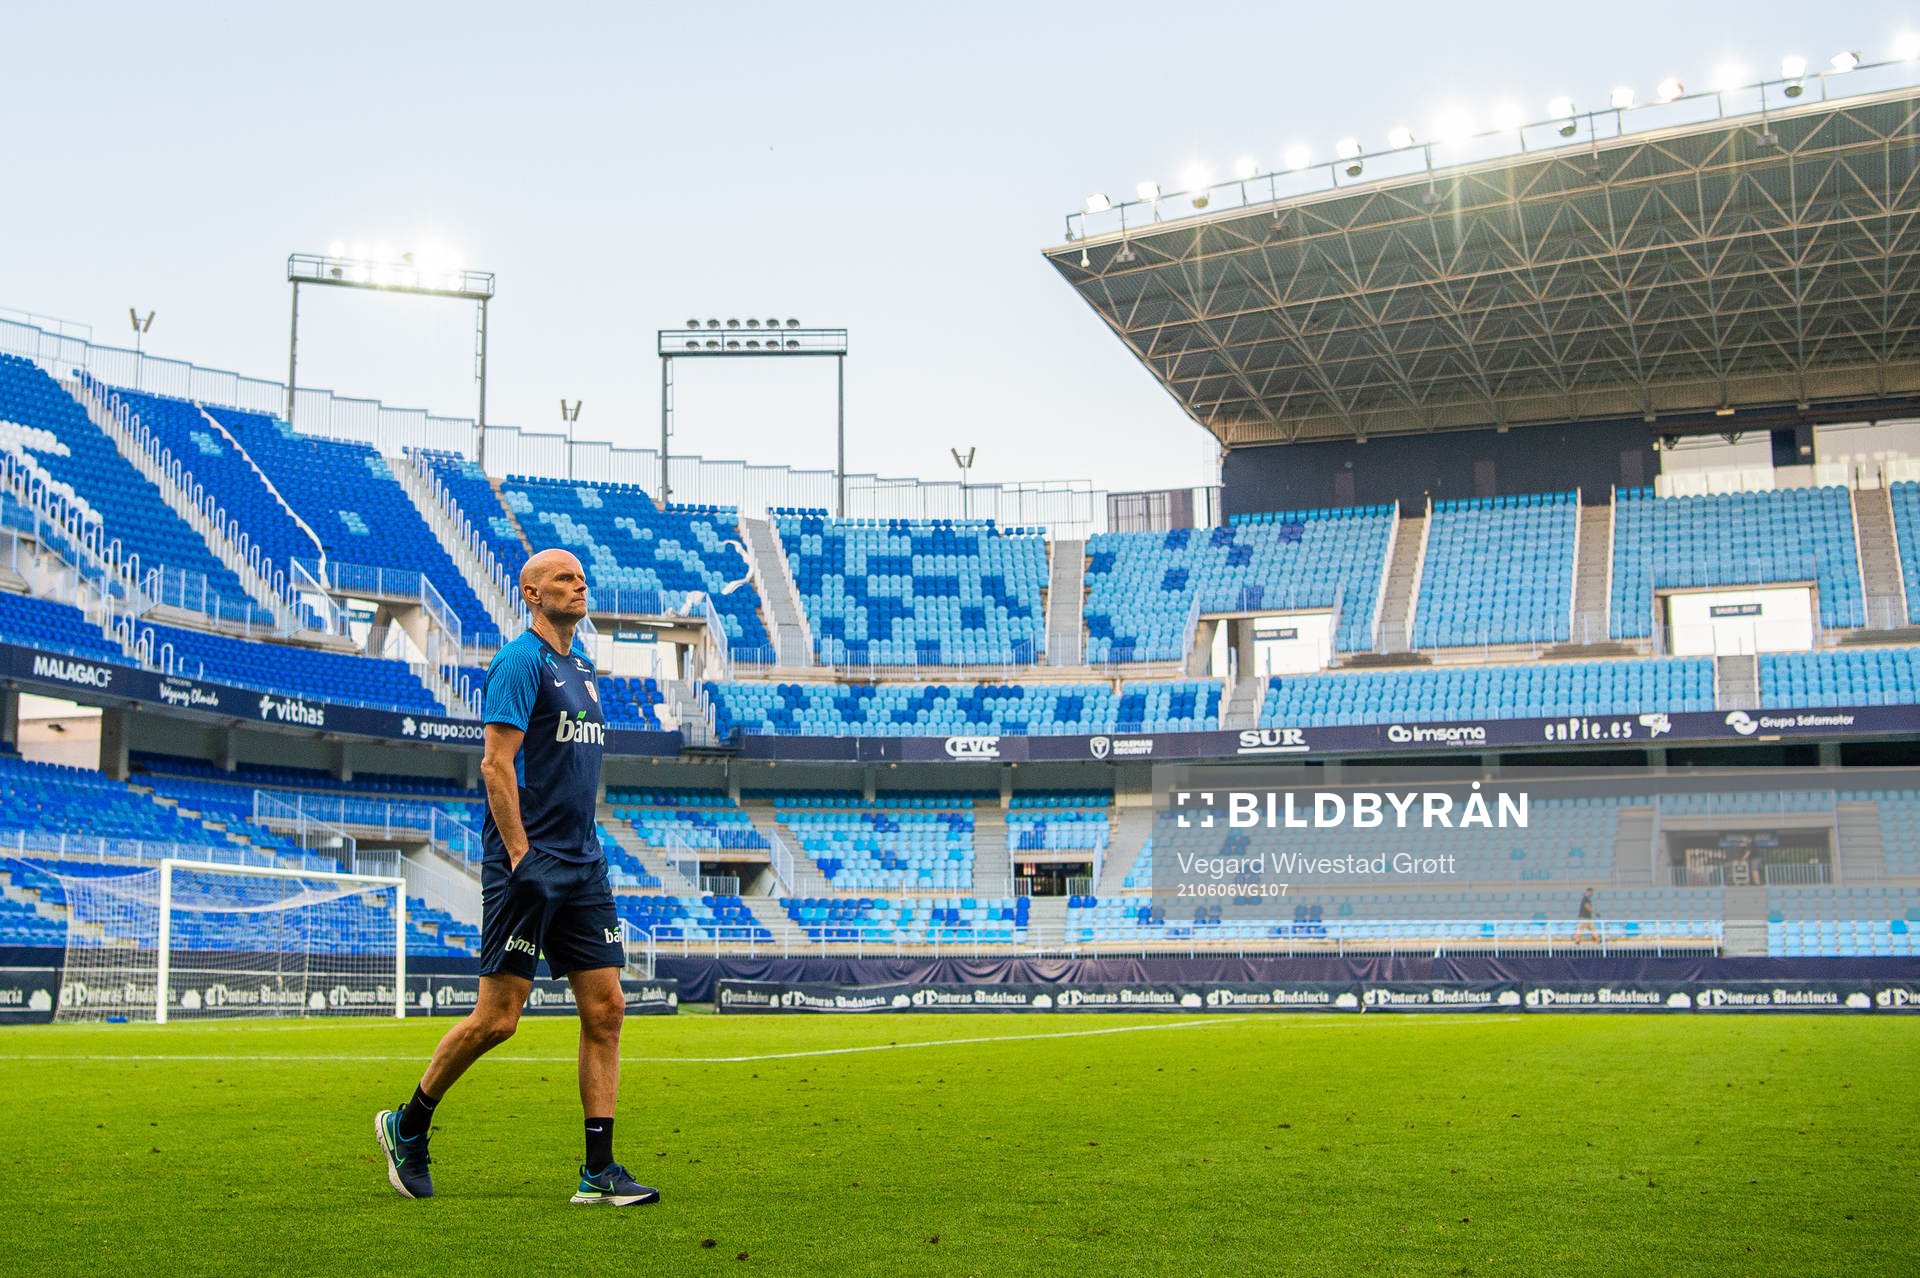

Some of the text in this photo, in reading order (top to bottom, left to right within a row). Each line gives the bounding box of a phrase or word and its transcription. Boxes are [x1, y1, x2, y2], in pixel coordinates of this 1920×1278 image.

[275, 698, 324, 726] vithas
[1760, 716, 1796, 729] Grupo
[1239, 729, 1305, 748] SUR
